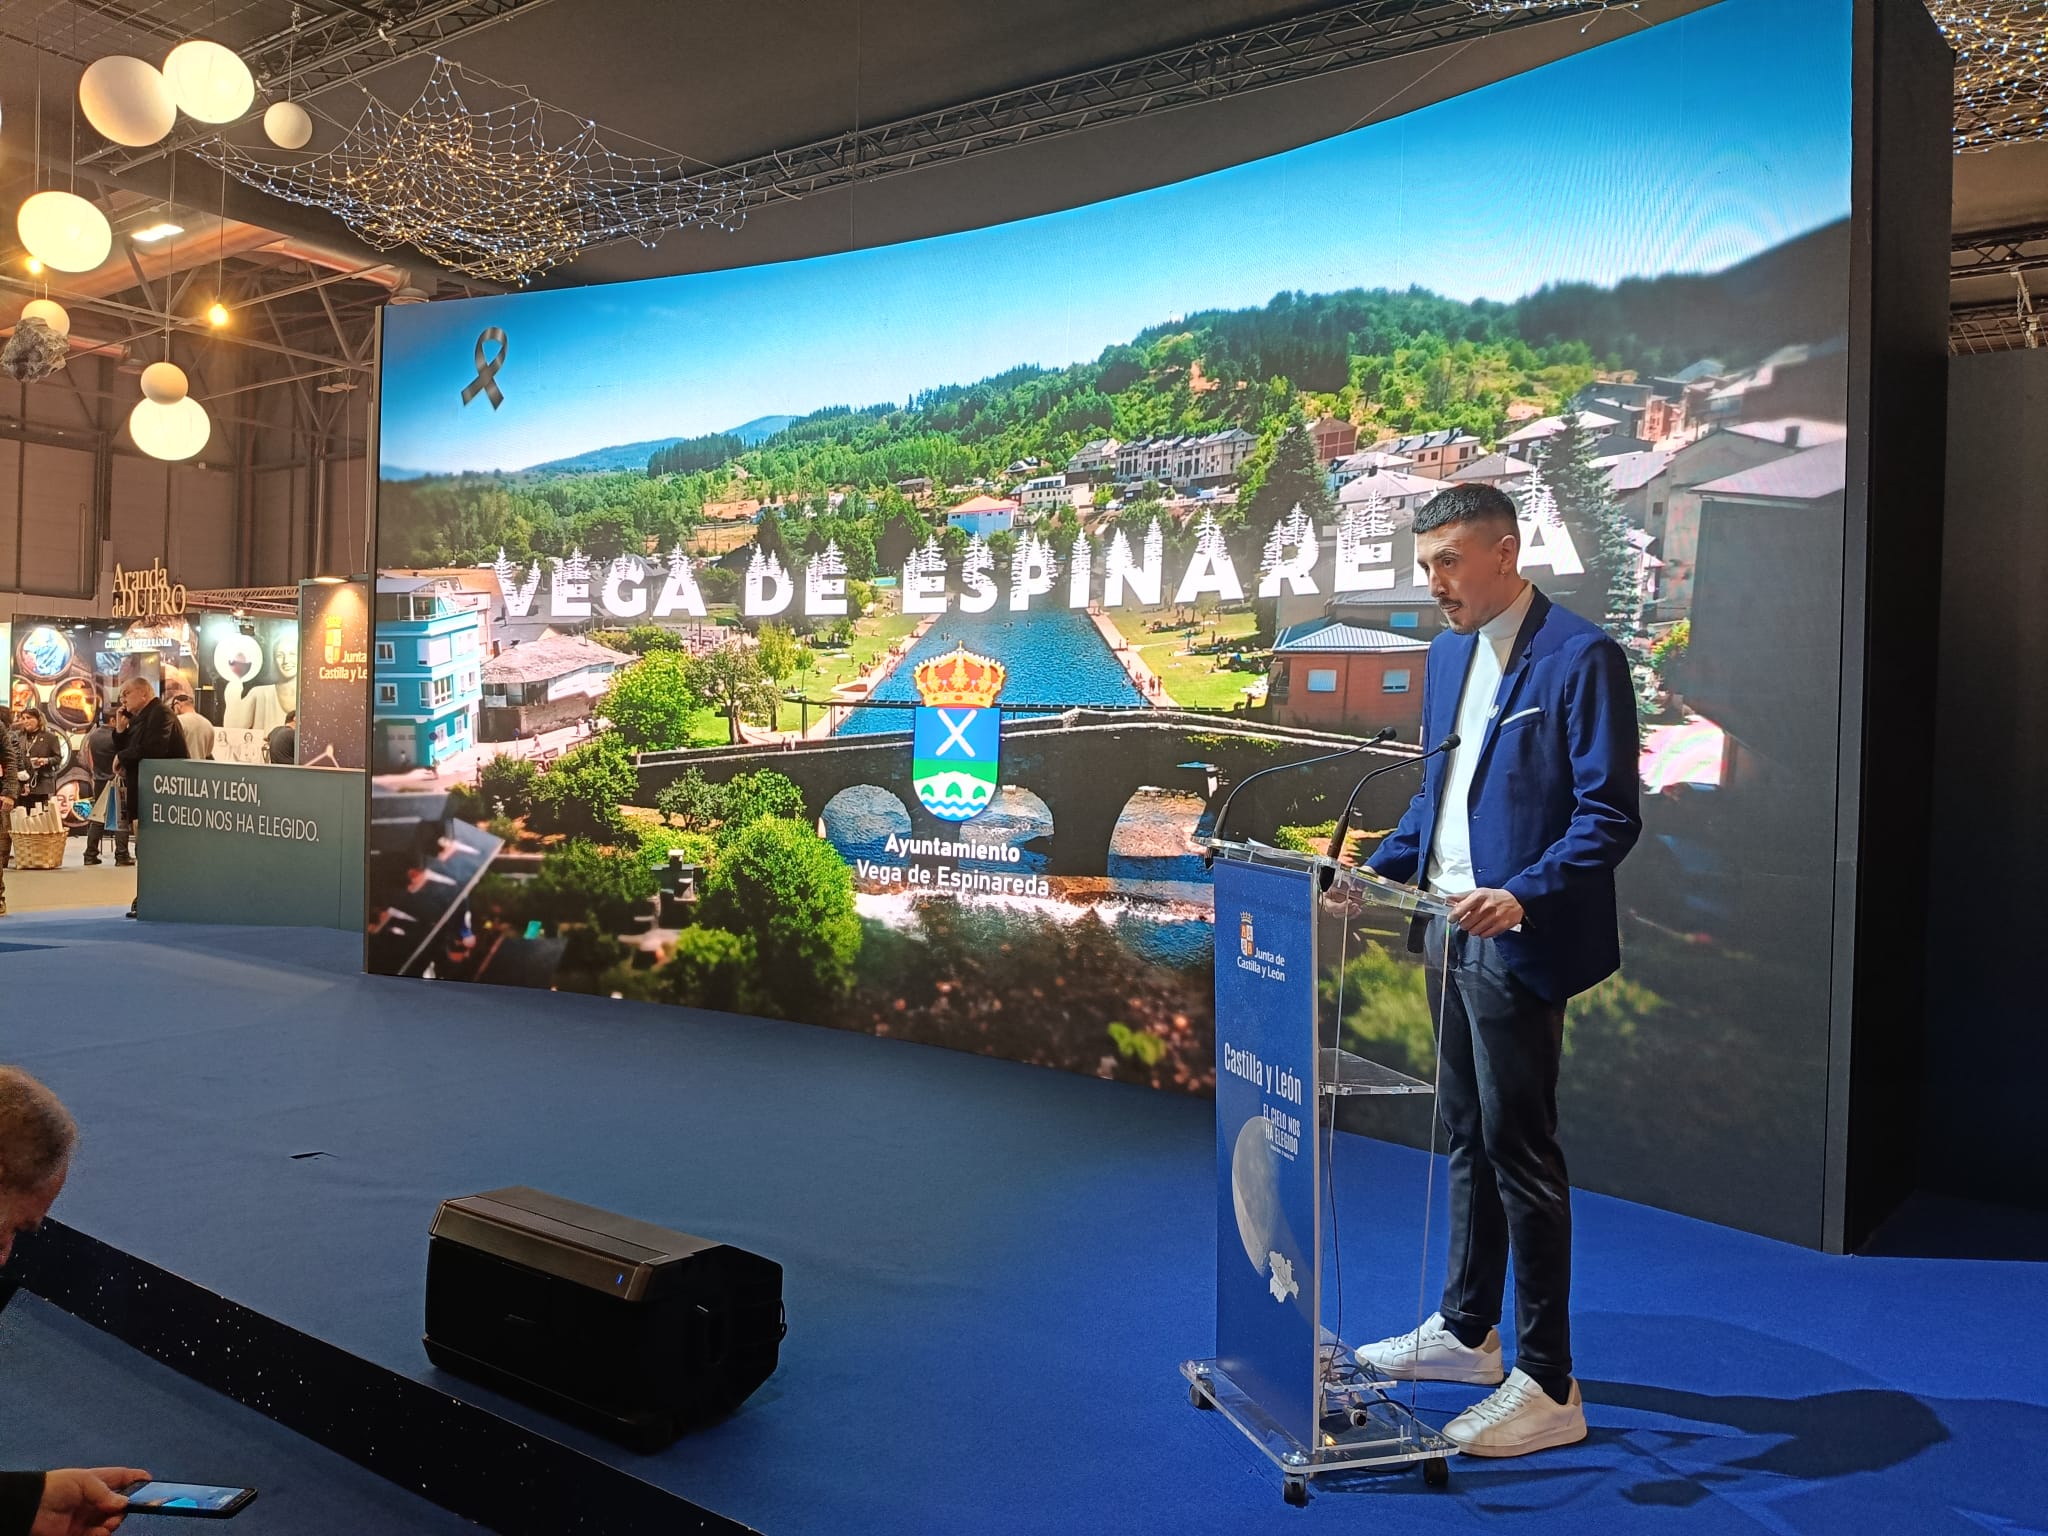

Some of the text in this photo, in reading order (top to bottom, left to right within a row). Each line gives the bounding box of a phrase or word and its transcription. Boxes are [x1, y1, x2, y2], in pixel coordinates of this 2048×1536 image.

[493, 467, 1585, 617] VEGA DE ESPINAREA
[112, 557, 168, 592] Aranda
[112, 584, 187, 618] de DUERO
[342, 650, 367, 663] Junta
[319, 666, 349, 679] Castilla
[350, 668, 357, 683] y
[153, 774, 261, 807] CASTILLA Y LEÓN,
[152, 803, 320, 842] EL CIELO NOS HA ELEGIDO.
[884, 833, 1021, 863] Ayuntamiento
[856, 859, 1049, 897] Vega de Espinareda
[1237, 956, 1286, 982] Castilla y León
[1254, 947, 1285, 967] Junta de
[1224, 1042, 1302, 1106] Castilla y León
[1263, 1103, 1301, 1138] EL CIELO NOS
[1265, 1123, 1274, 1142] HA
[1274, 1127, 1299, 1156] ELEGIDO
